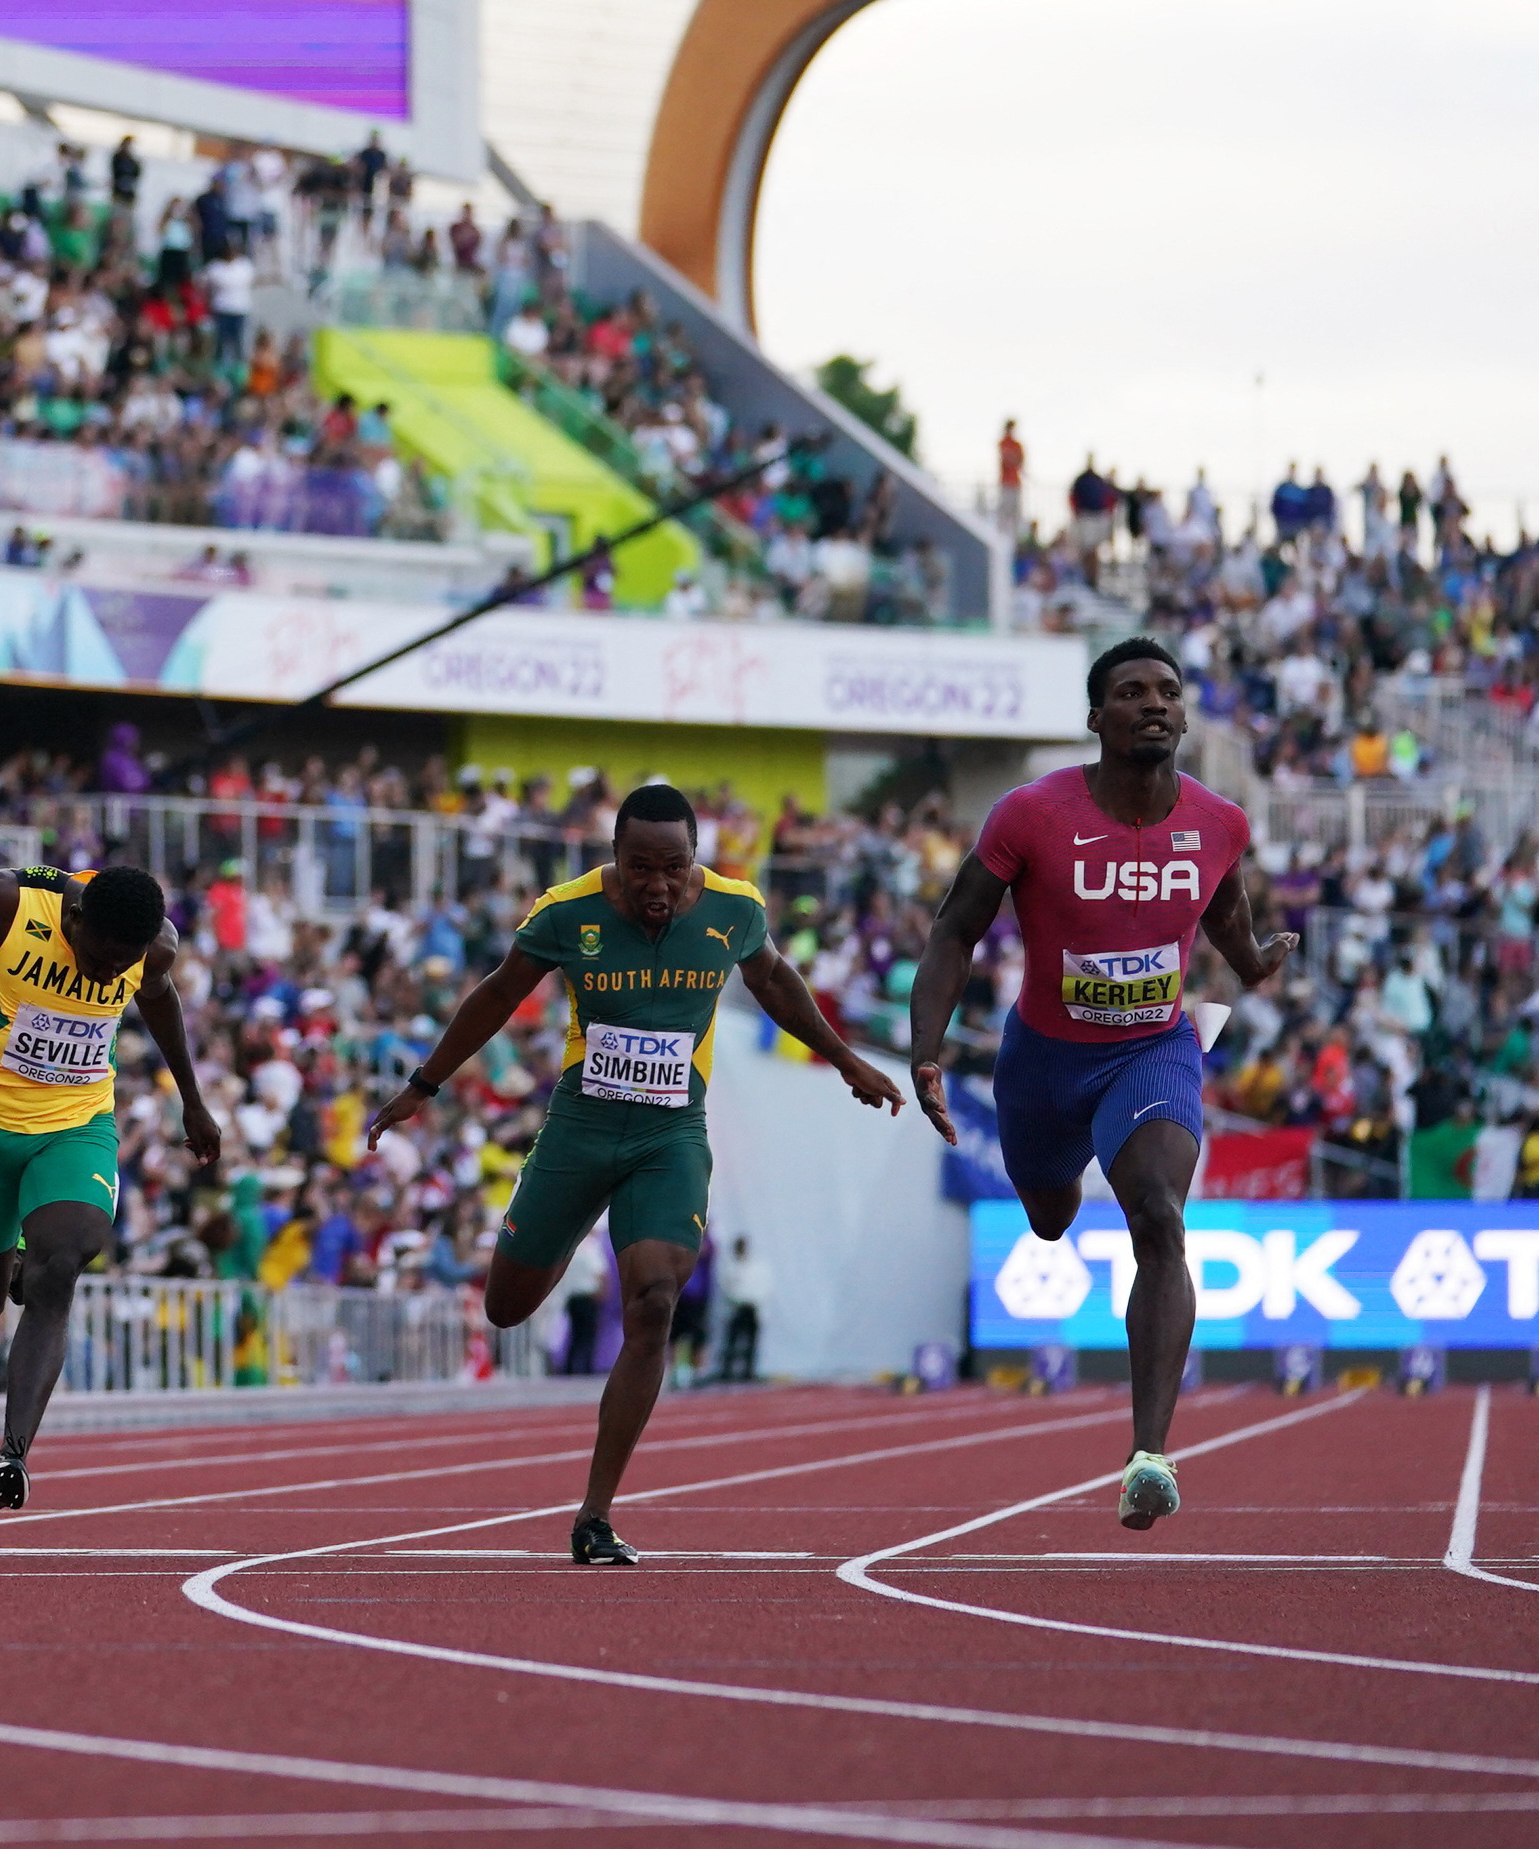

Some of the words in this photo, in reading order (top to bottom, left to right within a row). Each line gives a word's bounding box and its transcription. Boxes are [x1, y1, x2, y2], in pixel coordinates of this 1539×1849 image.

[822, 674, 1024, 718] OREGON22
[1074, 860, 1200, 901] USA
[7, 950, 126, 1006] JAMAICA
[1099, 950, 1165, 977] TDK
[583, 968, 652, 991] SOUTH
[659, 968, 725, 990] AFRICA
[1074, 975, 1172, 1006] KERLEY
[52, 1017, 108, 1039] TDK
[1082, 1009, 1164, 1024] OREGON22
[14, 1032, 106, 1066] SEVILLE
[619, 1034, 681, 1057] TDK
[18, 1064, 91, 1084] OREGON22
[590, 1052, 685, 1085] SIMBINE
[597, 1087, 672, 1107] OREGON22
[1077, 1230, 1362, 1319] TDK
